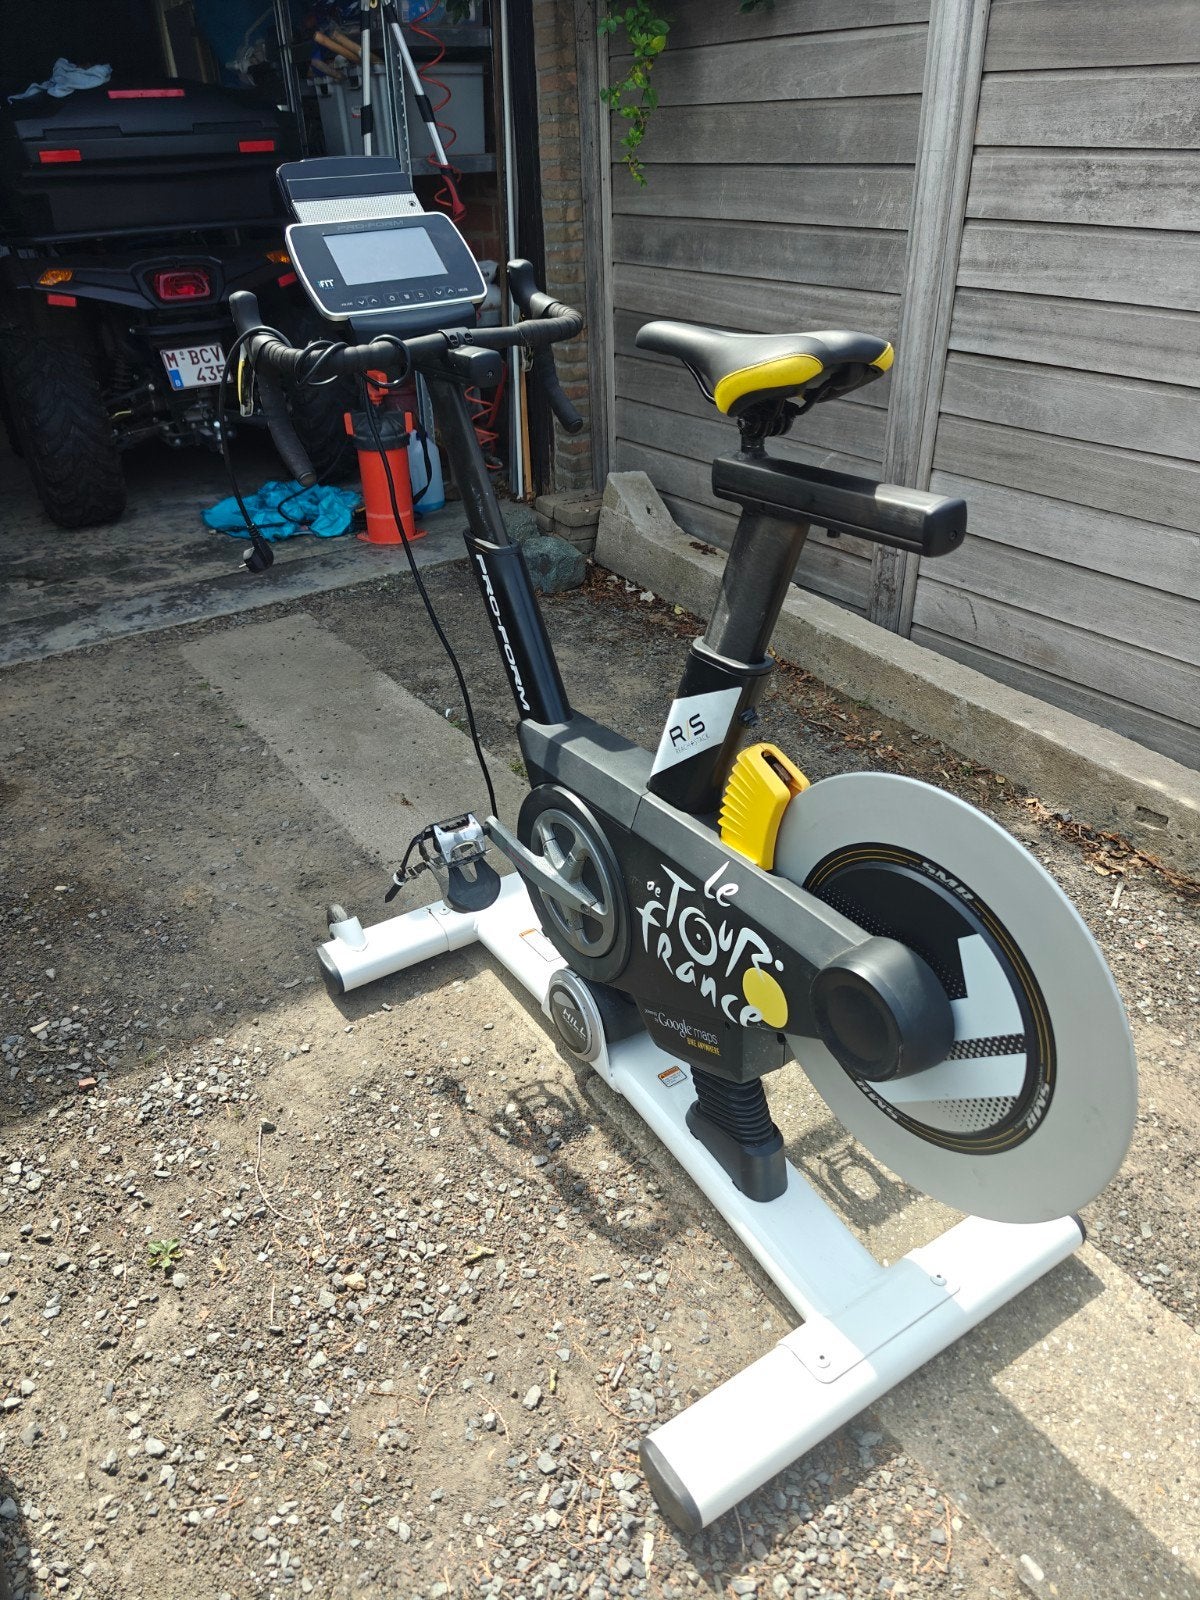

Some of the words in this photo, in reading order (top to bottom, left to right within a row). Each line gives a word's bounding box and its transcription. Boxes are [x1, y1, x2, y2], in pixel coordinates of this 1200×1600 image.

[475, 554, 531, 711] PRO-FORM
[562, 1008, 587, 1038] HILL
[658, 1011, 692, 1039] Google
[693, 1027, 718, 1045] maps
